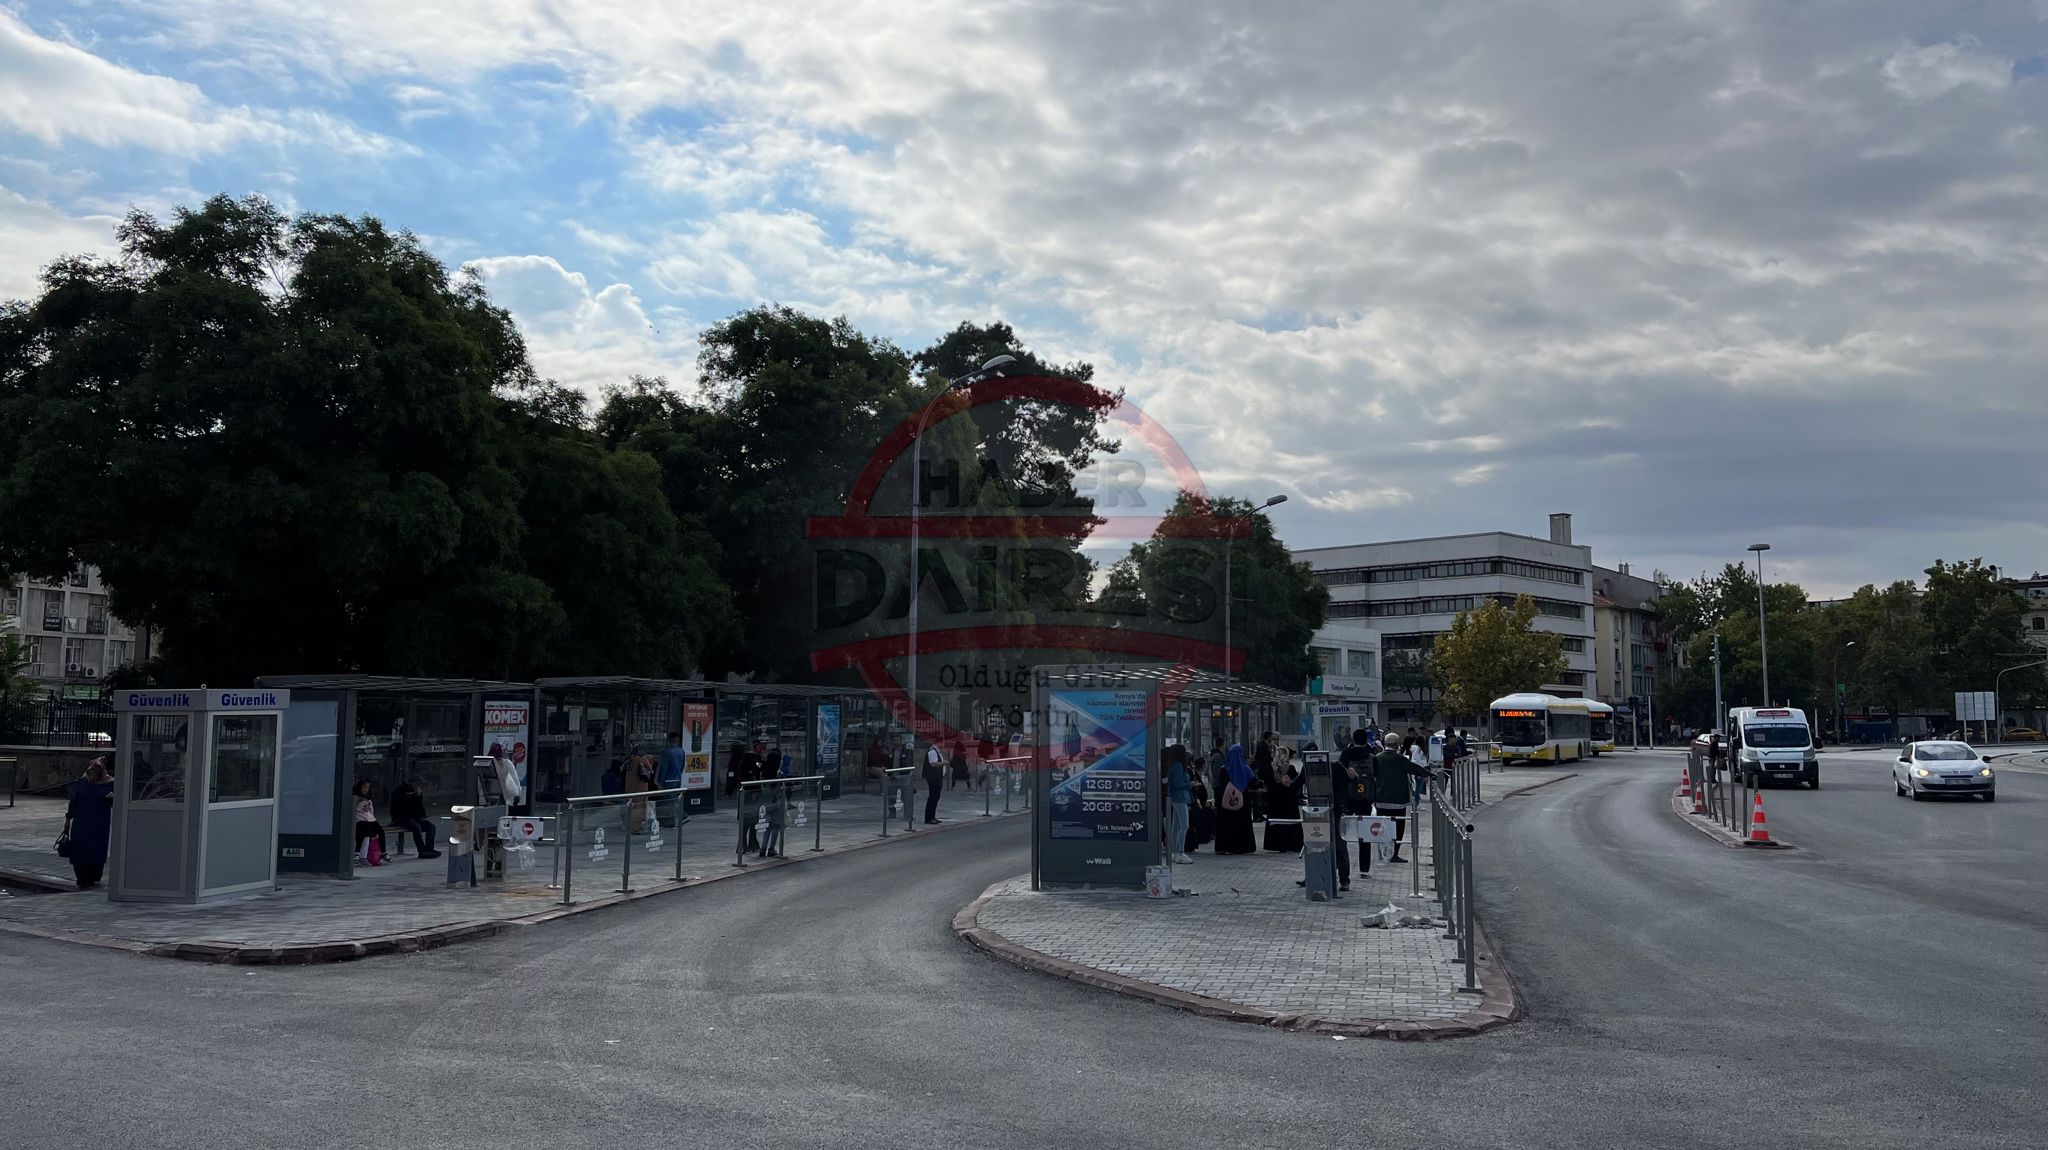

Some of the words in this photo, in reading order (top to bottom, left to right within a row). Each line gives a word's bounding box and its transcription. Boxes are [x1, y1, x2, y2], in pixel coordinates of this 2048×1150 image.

[129, 693, 190, 707] Güvenlik
[221, 693, 276, 706] Güvenlik
[1114, 693, 1146, 701] Konya'da
[485, 710, 525, 724] KOMEK
[1121, 780, 1142, 790] 100
[1121, 802, 1141, 812] 120
